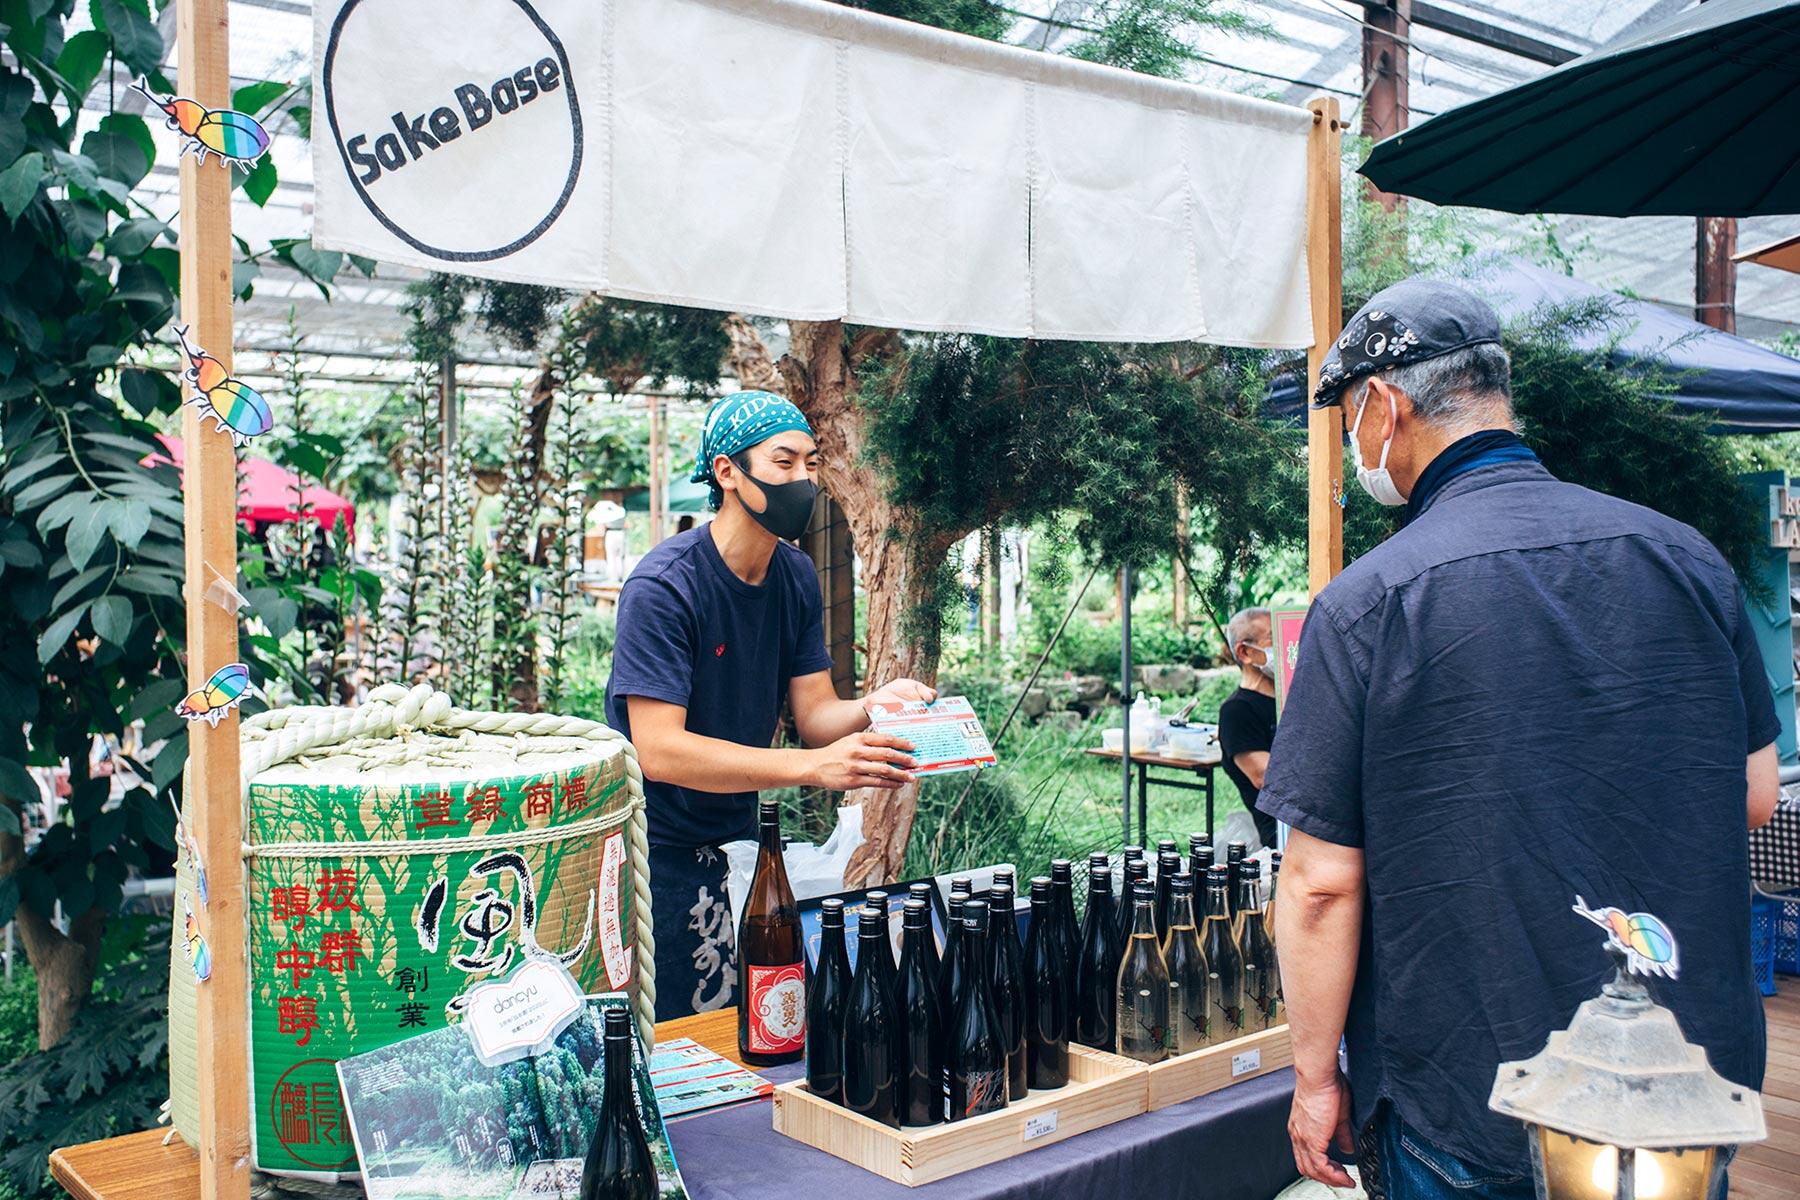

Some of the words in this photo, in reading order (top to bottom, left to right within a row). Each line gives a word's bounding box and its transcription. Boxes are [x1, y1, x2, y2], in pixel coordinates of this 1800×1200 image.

[413, 775, 589, 831] 登録商標
[395, 965, 430, 1029] 創業
[494, 985, 538, 1014] dancyu
